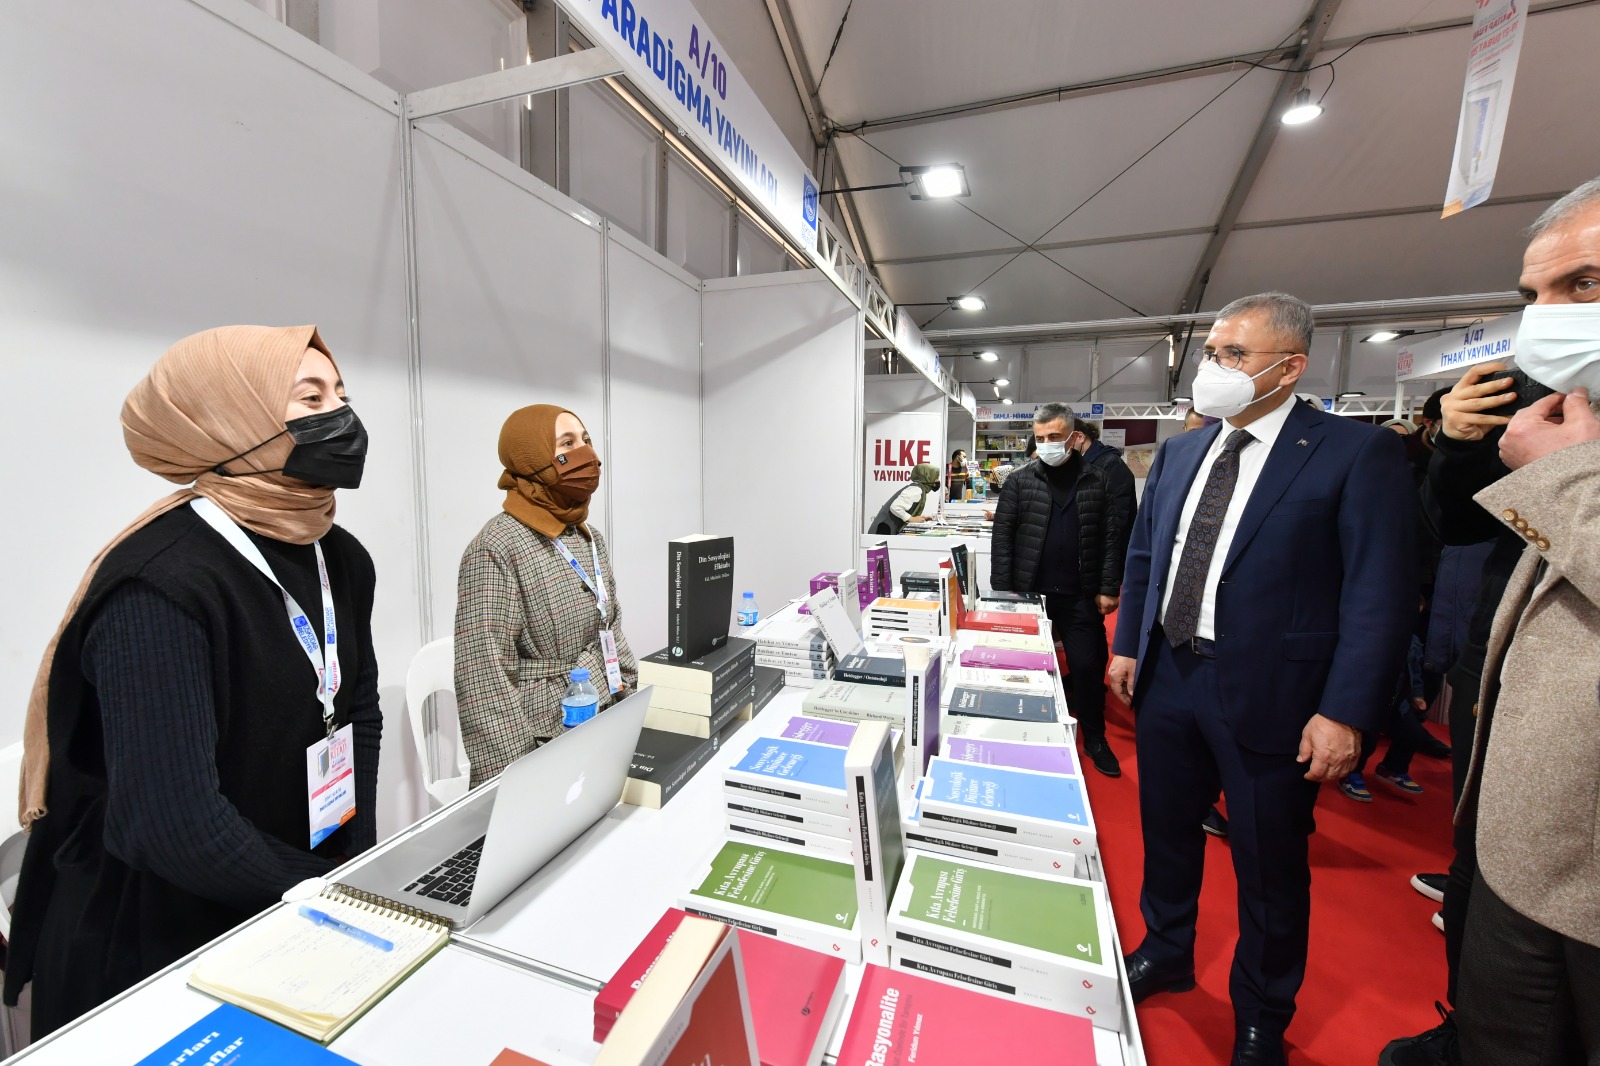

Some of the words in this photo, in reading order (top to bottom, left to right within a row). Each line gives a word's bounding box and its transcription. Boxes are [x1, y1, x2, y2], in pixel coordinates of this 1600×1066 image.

[688, 24, 727, 100] A/10
[715, 107, 778, 205] YAYINLARI
[1464, 329, 1484, 345] A/47
[1441, 347, 1466, 367] İTHAKİ
[1467, 339, 1511, 360] YAYINLARI
[875, 439, 931, 467] İLKE
[873, 469, 912, 482] YAYINC
[708, 552, 731, 562] Sosyolojisi
[843, 672, 863, 680] Heidegger
[749, 745, 779, 772] Sosyolojik
[762, 752, 788, 774] Düşünce
[947, 770, 964, 801] Sosyolojik
[962, 779, 979, 804] Düşünce
[981, 780, 999, 807] Geleneği
[859, 803, 867, 827] Avrupası
[713, 880, 732, 896] Kıta
[724, 853, 750, 885] Avrupası
[726, 861, 756, 899] Felsefesine
[751, 850, 767, 869] Giriş
[932, 870, 950, 907] Avrupası
[942, 881, 961, 924] Felsefesine
[953, 867, 967, 888] Giriş
[925, 900, 940, 920] Kıta
[912, 936, 925, 944] Kıta
[924, 938, 949, 954] Avrupası
[949, 945, 980, 960] Felsefesine
[979, 953, 994, 963] Giriş
[916, 963, 929, 971] Kıta
[928, 965, 954, 980] Avrupası
[953, 971, 984, 987] Felsefesine
[983, 979, 998, 989] Giriş
[1036, 968, 1049, 976] WEST
[1023, 991, 1038, 999] DAVID
[863, 987, 900, 1066] Rasyonalite
[912, 1013, 923, 1035] Yılmaz
[907, 1036, 919, 1063] Feridun
